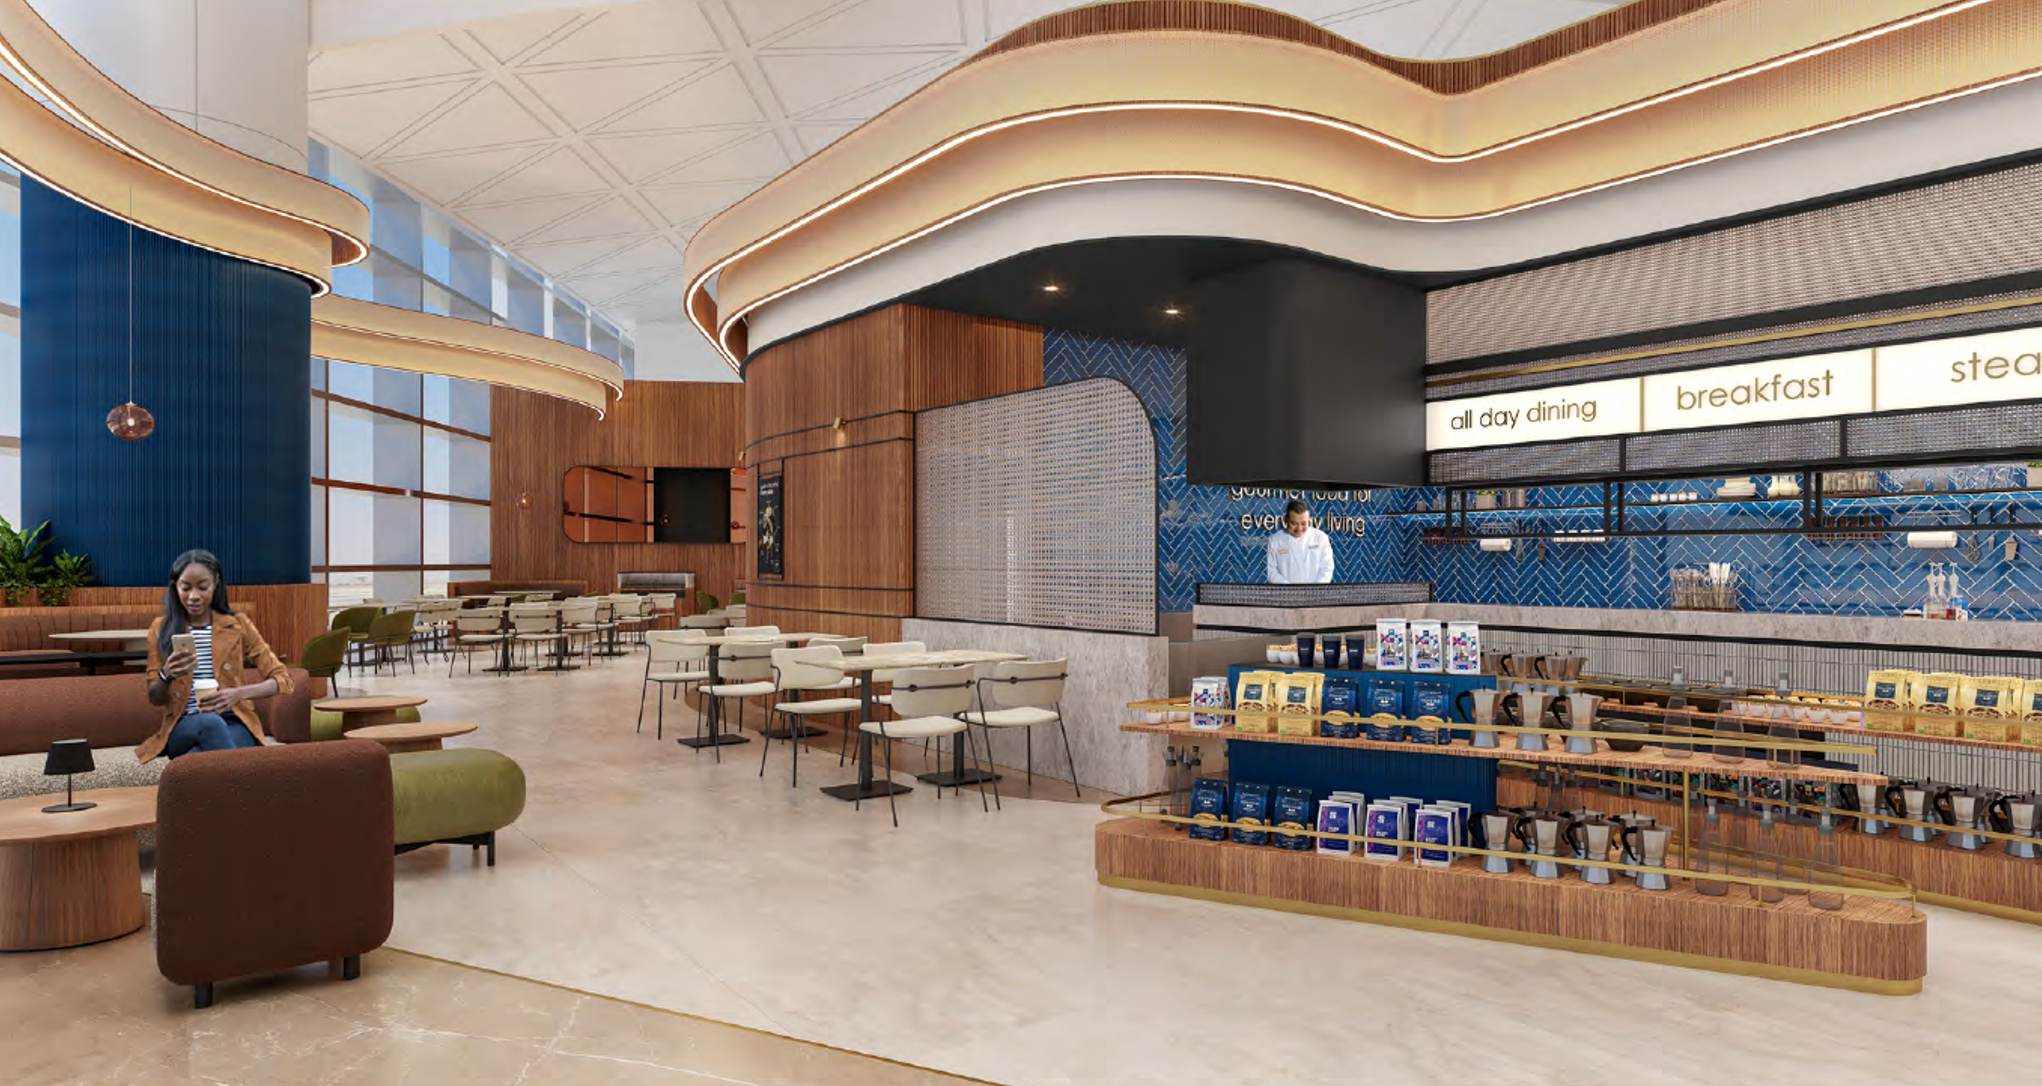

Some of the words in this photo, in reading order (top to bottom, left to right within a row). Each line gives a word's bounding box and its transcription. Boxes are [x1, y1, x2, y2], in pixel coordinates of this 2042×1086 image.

[1950, 352, 2041, 383] stea
[1677, 369, 1834, 411] breakfast
[1451, 409, 1473, 430] all
[1479, 408, 1520, 429] day
[1526, 399, 1597, 423] dining
[1326, 511, 1365, 537] living
